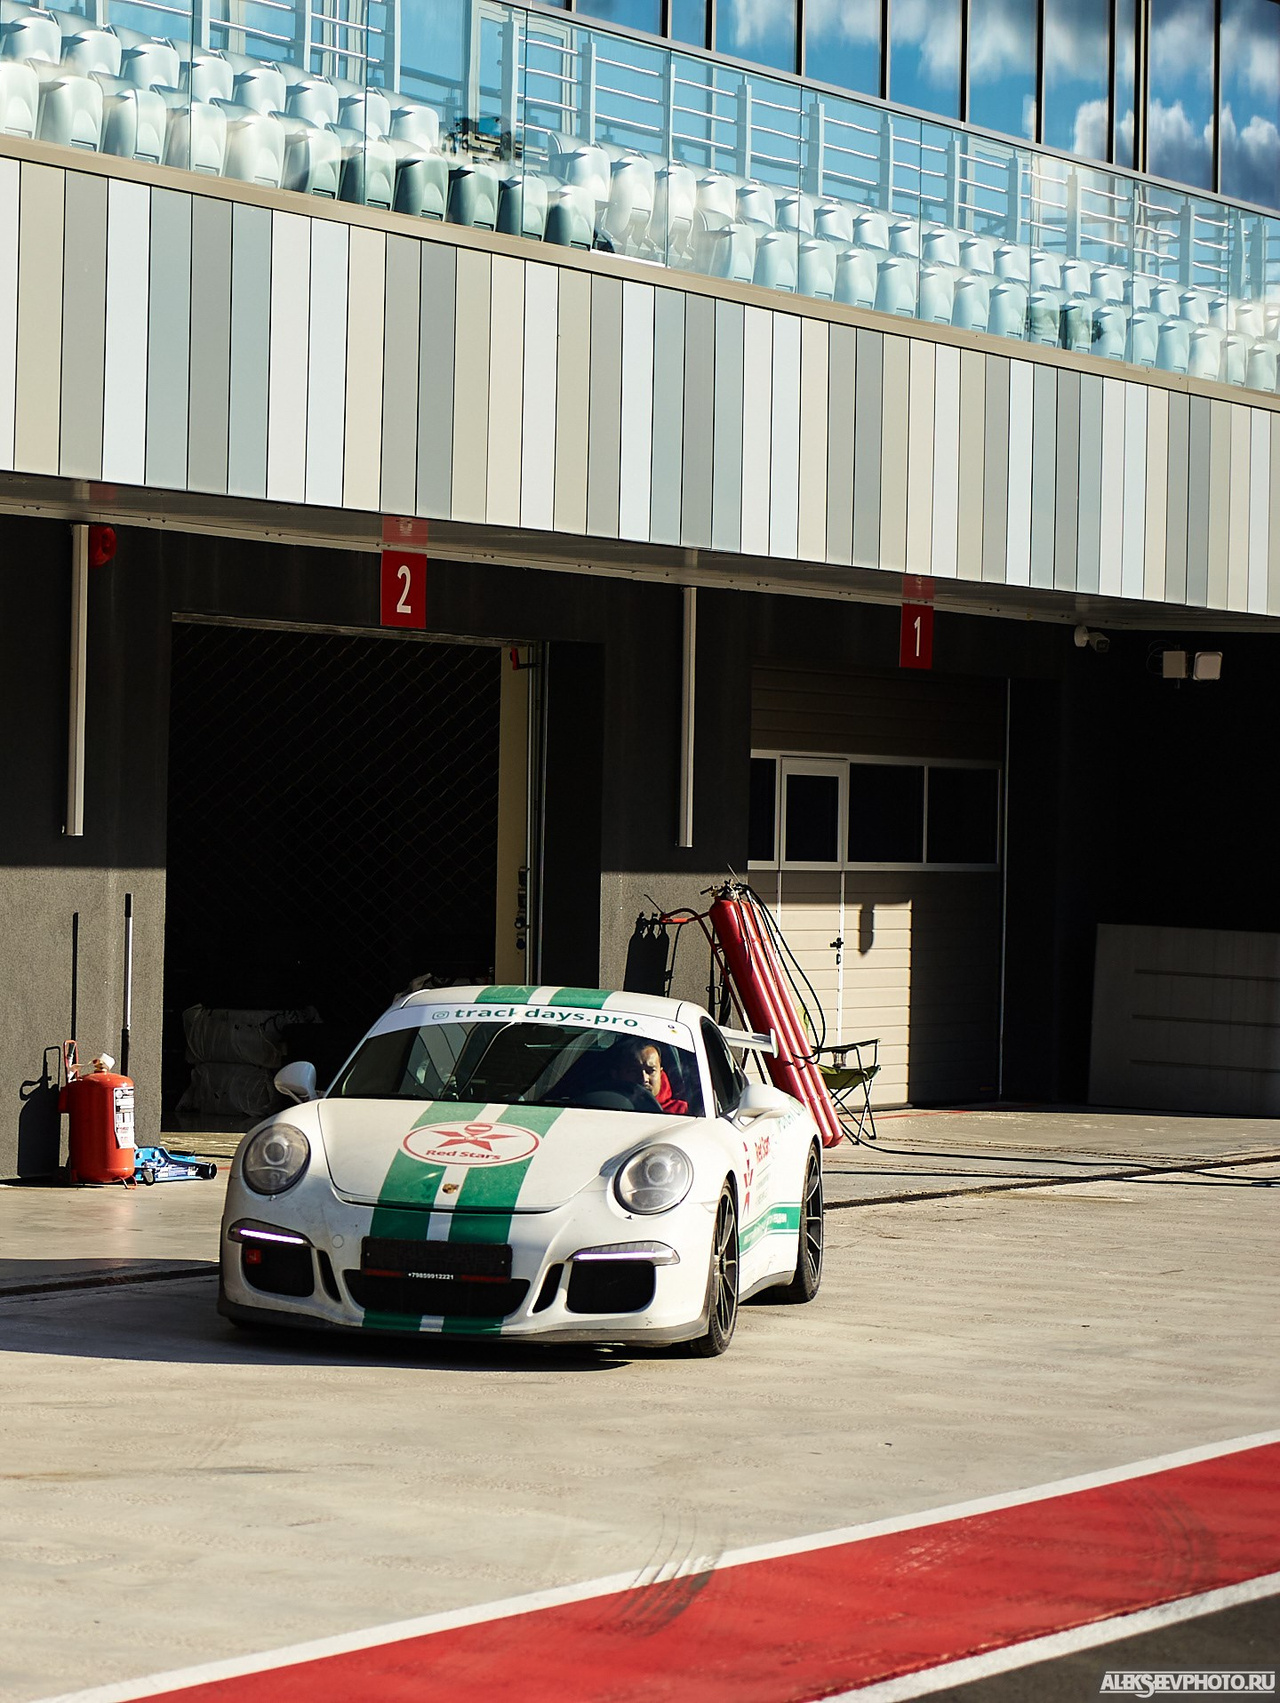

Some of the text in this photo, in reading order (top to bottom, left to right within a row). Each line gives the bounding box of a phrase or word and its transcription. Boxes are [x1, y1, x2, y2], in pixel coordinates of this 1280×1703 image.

[396, 564, 412, 614] 2
[914, 616, 921, 657] 1
[460, 1151, 501, 1160] Stars
